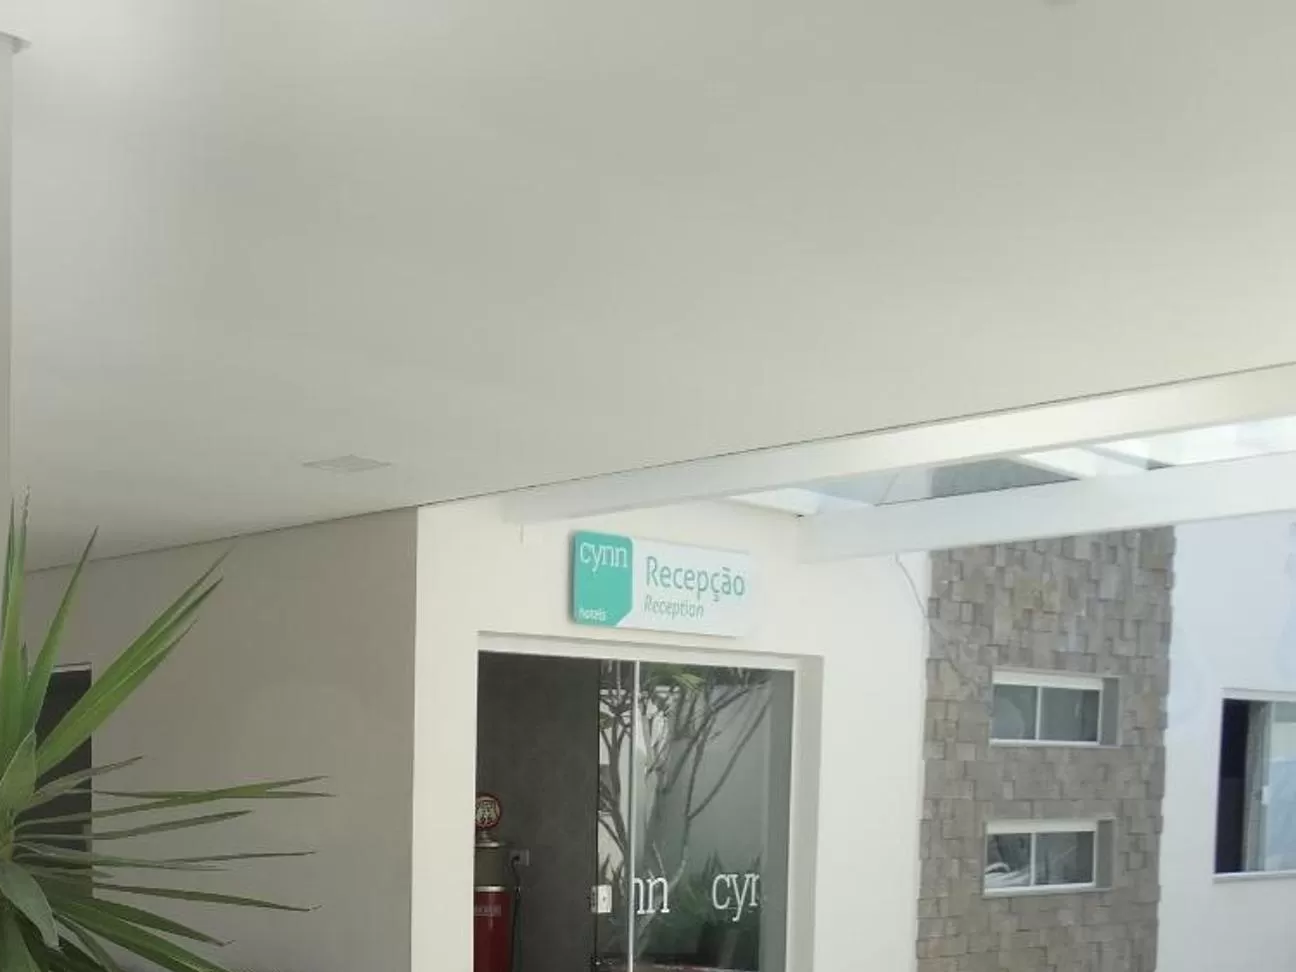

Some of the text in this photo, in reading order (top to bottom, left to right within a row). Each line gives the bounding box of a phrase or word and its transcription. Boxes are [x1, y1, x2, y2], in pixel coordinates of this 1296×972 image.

[579, 542, 627, 572] cynn
[646, 556, 745, 602] Recepção
[644, 596, 704, 619] Reception
